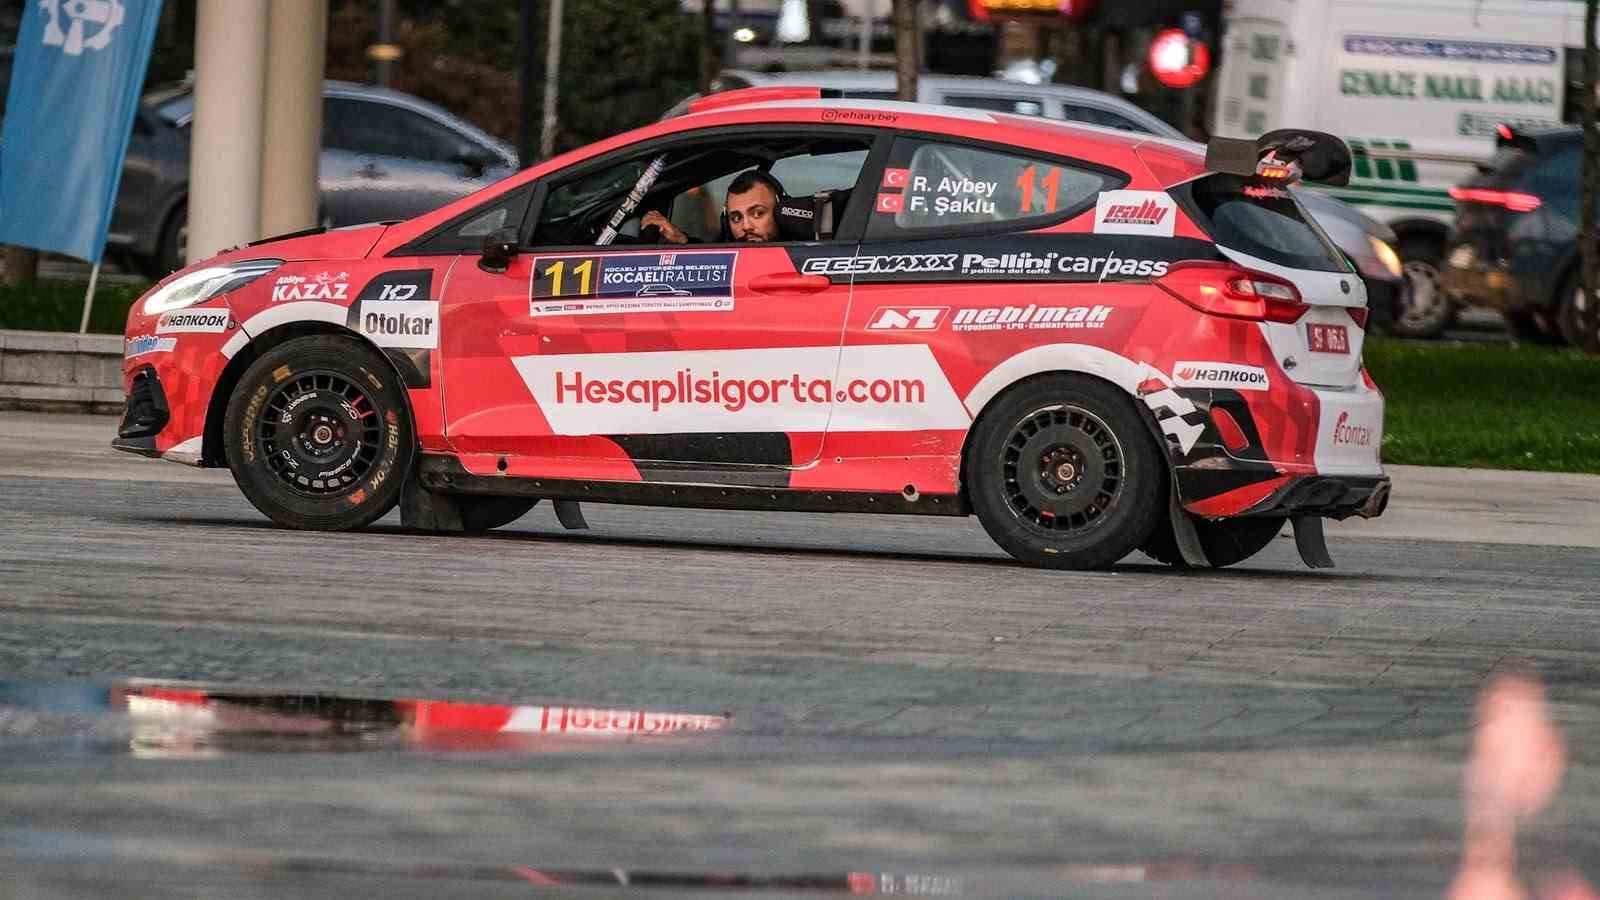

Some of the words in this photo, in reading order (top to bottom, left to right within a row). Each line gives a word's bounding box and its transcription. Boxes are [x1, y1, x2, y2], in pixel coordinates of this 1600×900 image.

[913, 177, 932, 192] R.
[937, 177, 998, 195] Aybey
[1016, 163, 1061, 214] 11
[781, 206, 814, 219] sparco
[910, 198, 929, 212] F.
[935, 197, 995, 216] Şaklu
[544, 260, 593, 297] 11
[271, 283, 349, 302] KAZAZ
[951, 304, 1114, 324] nebimak
[365, 312, 433, 336] Otokar
